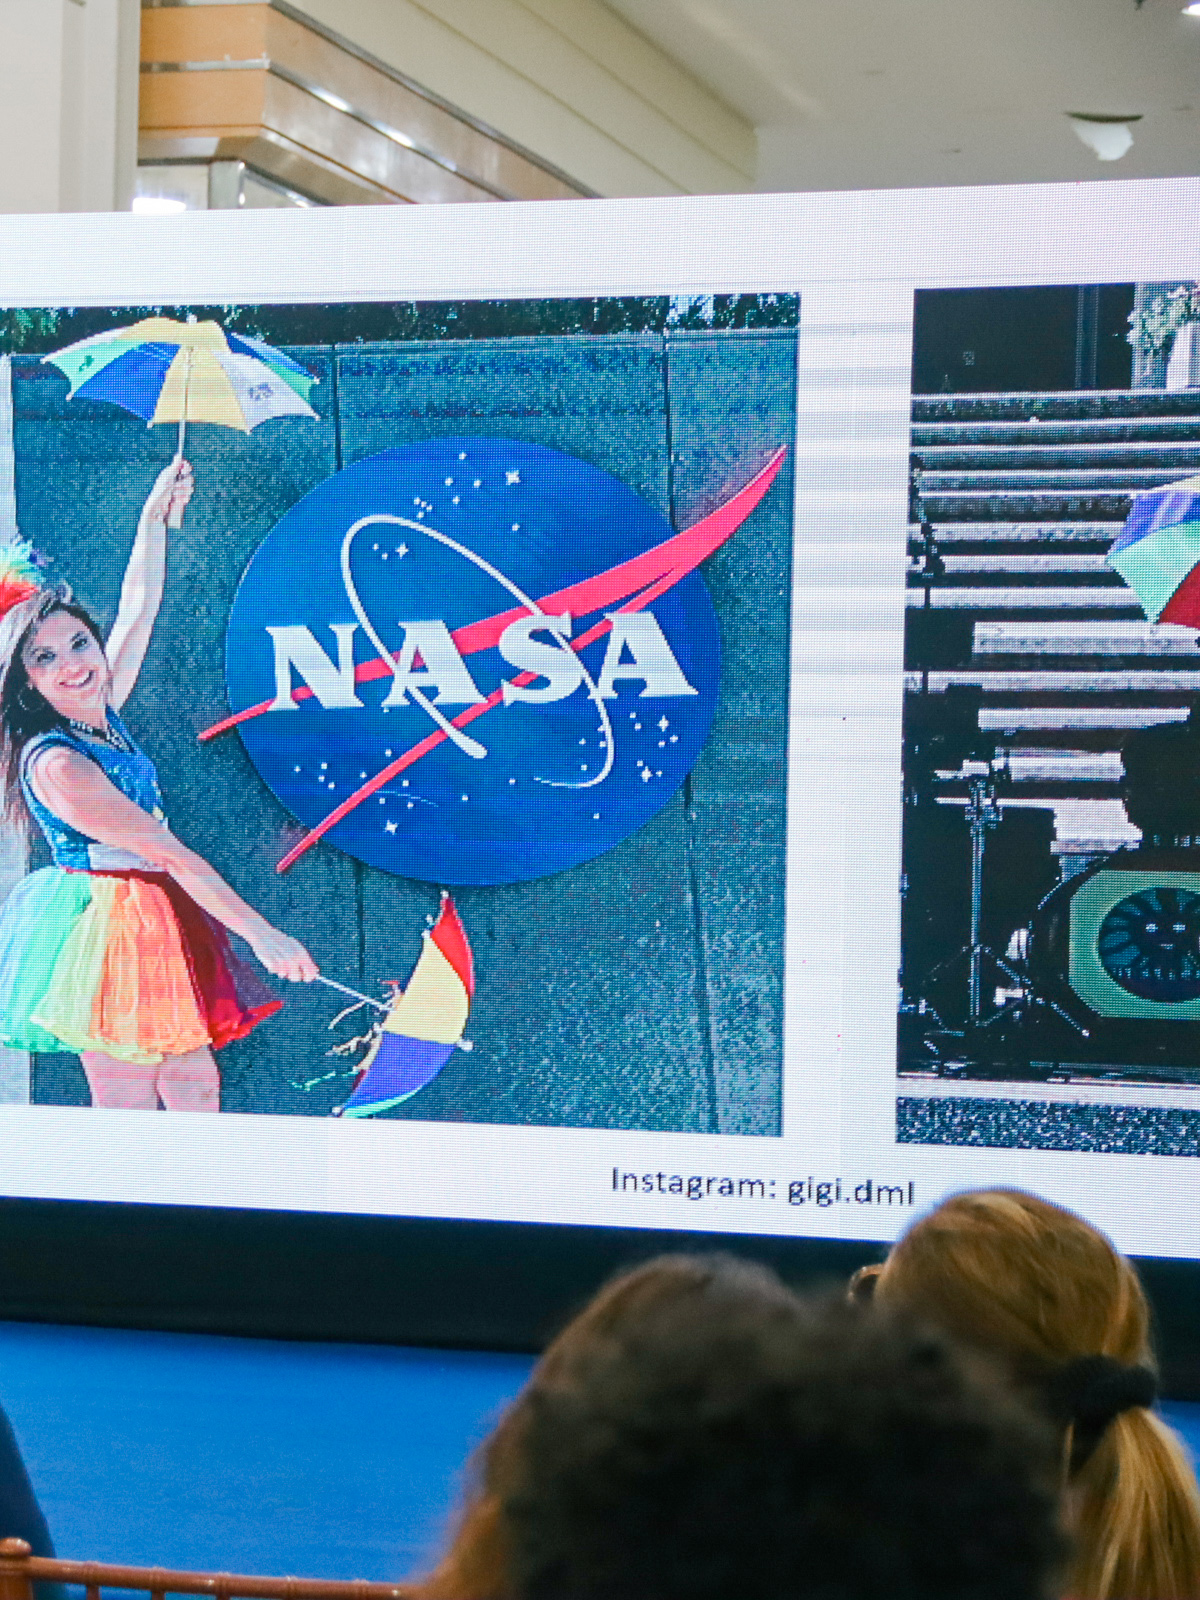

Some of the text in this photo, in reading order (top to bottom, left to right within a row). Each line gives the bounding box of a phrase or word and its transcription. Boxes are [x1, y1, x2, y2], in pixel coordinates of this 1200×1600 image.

[266, 611, 699, 711] NASA
[612, 1167, 915, 1207] Instagram: gigi.dml
